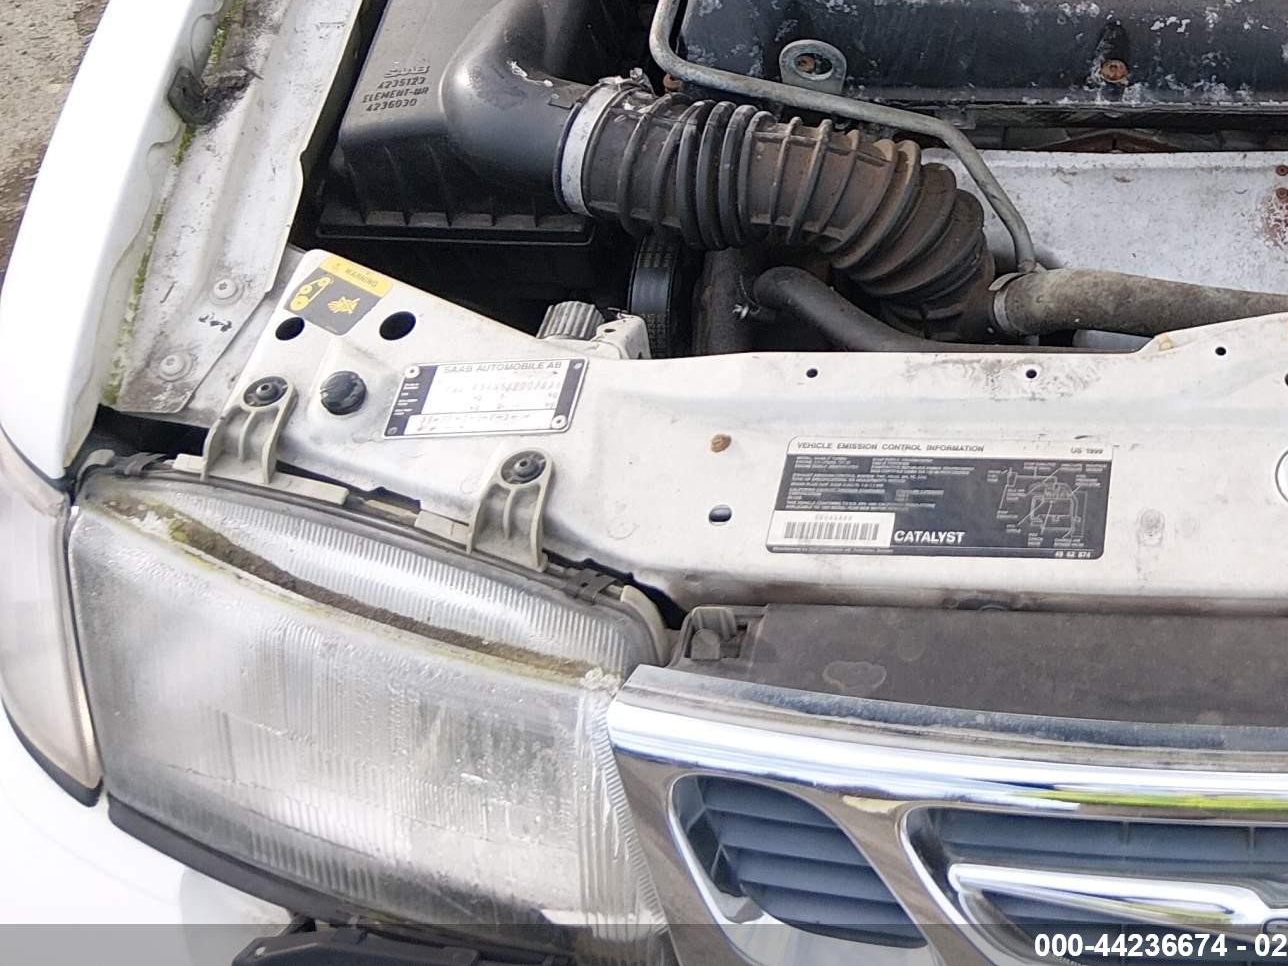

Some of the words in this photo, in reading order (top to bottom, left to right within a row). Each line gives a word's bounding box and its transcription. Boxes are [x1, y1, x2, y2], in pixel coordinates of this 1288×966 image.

[443, 365, 473, 374] SAAB
[476, 362, 543, 373] AUTOMOBILE
[547, 361, 562, 370] AB
[797, 442, 832, 450] VEHICLE
[837, 442, 878, 451] EMISSION
[882, 443, 922, 451] CONTROL
[926, 444, 985, 453] INFORMATION
[893, 530, 965, 544] CATALYST
